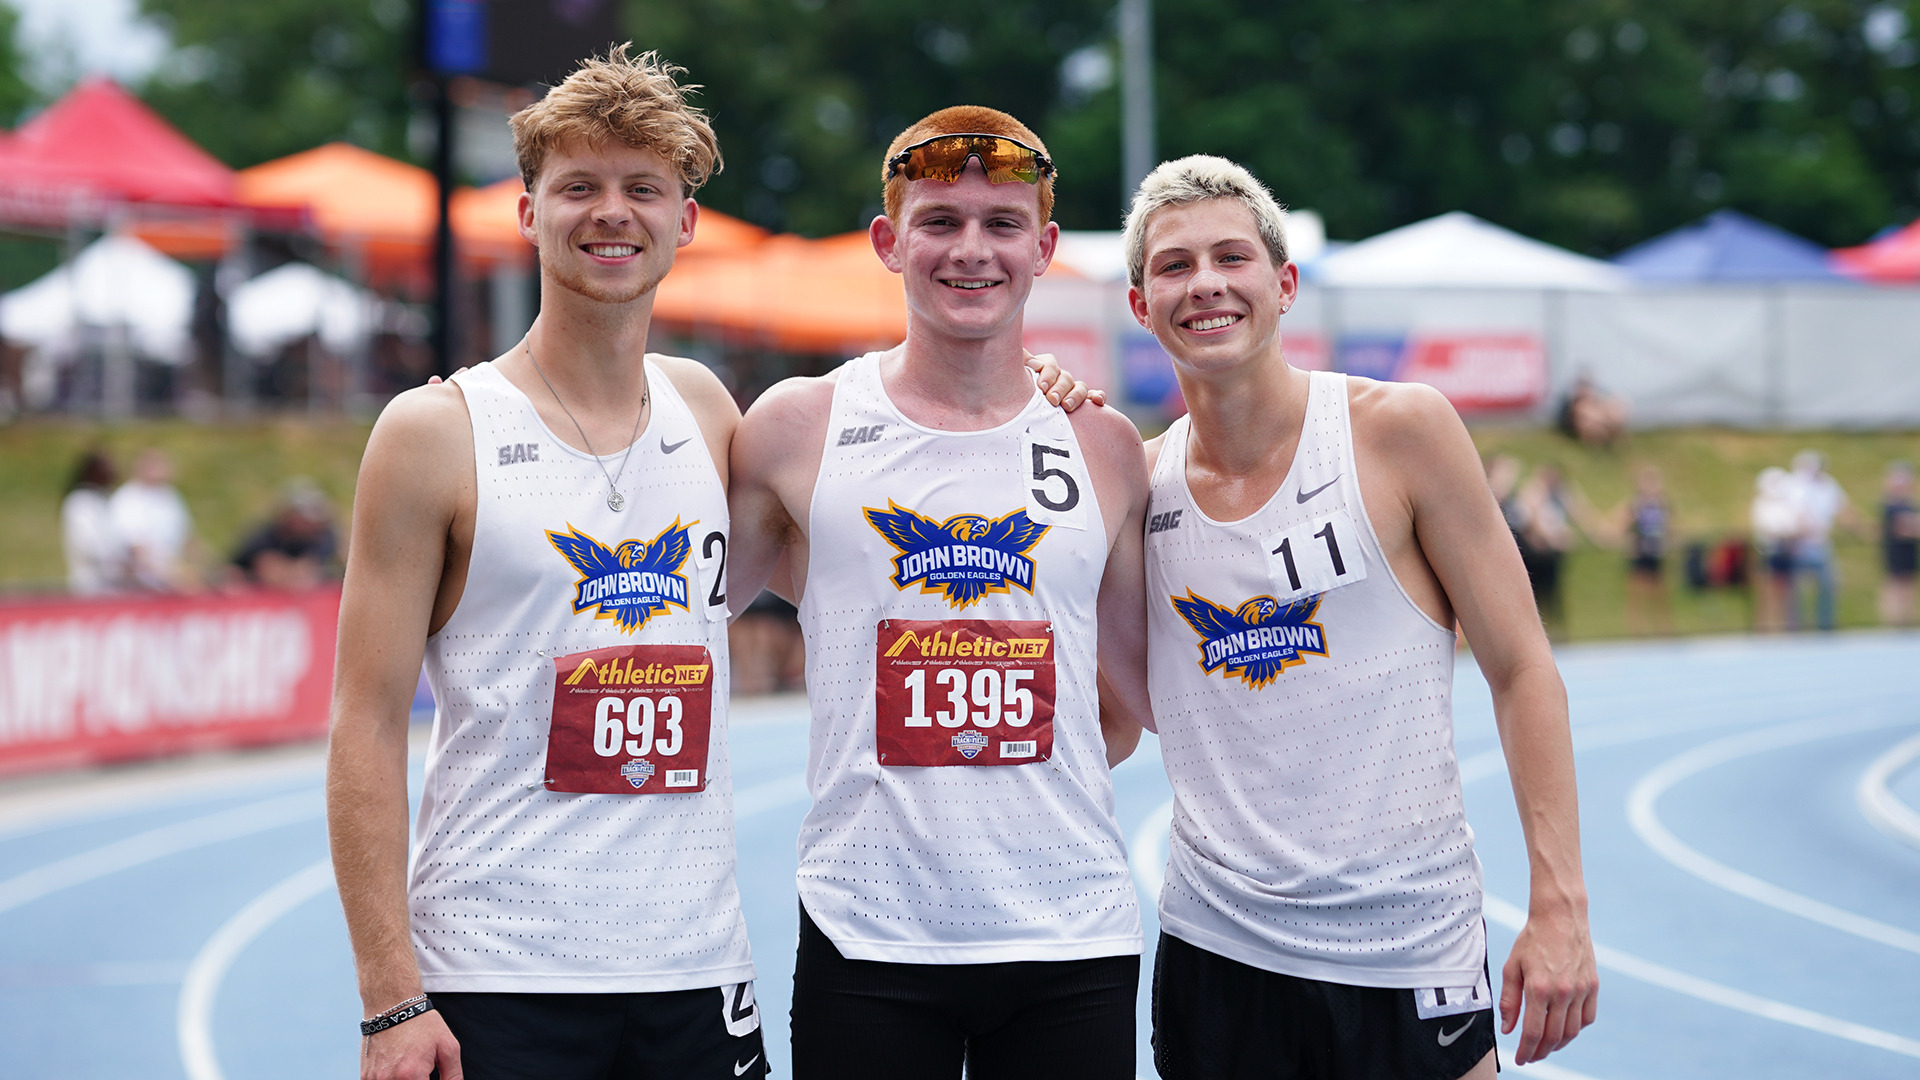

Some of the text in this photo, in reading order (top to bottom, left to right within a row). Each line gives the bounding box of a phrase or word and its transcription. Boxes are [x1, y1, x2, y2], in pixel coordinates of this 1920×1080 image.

[837, 424, 885, 447] SAC
[498, 443, 539, 467] SAC
[1031, 443, 1080, 512] 5
[1149, 508, 1183, 535] SAC
[702, 531, 726, 607] 2
[901, 544, 1030, 584] JOHN BROWN
[1271, 521, 1346, 592] 11
[578, 571, 685, 606] JOHN BROWN
[929, 571, 1001, 581] GOLDEN EAGLES
[632, 595, 661, 605] EAGLES
[1205, 626, 1321, 667] JOHN BROWN
[1228, 647, 1294, 666] GOLDEN EAGLES
[904, 668, 1034, 728] 1395
[593, 696, 683, 757] 693
[390, 1007, 416, 1023] FCA
